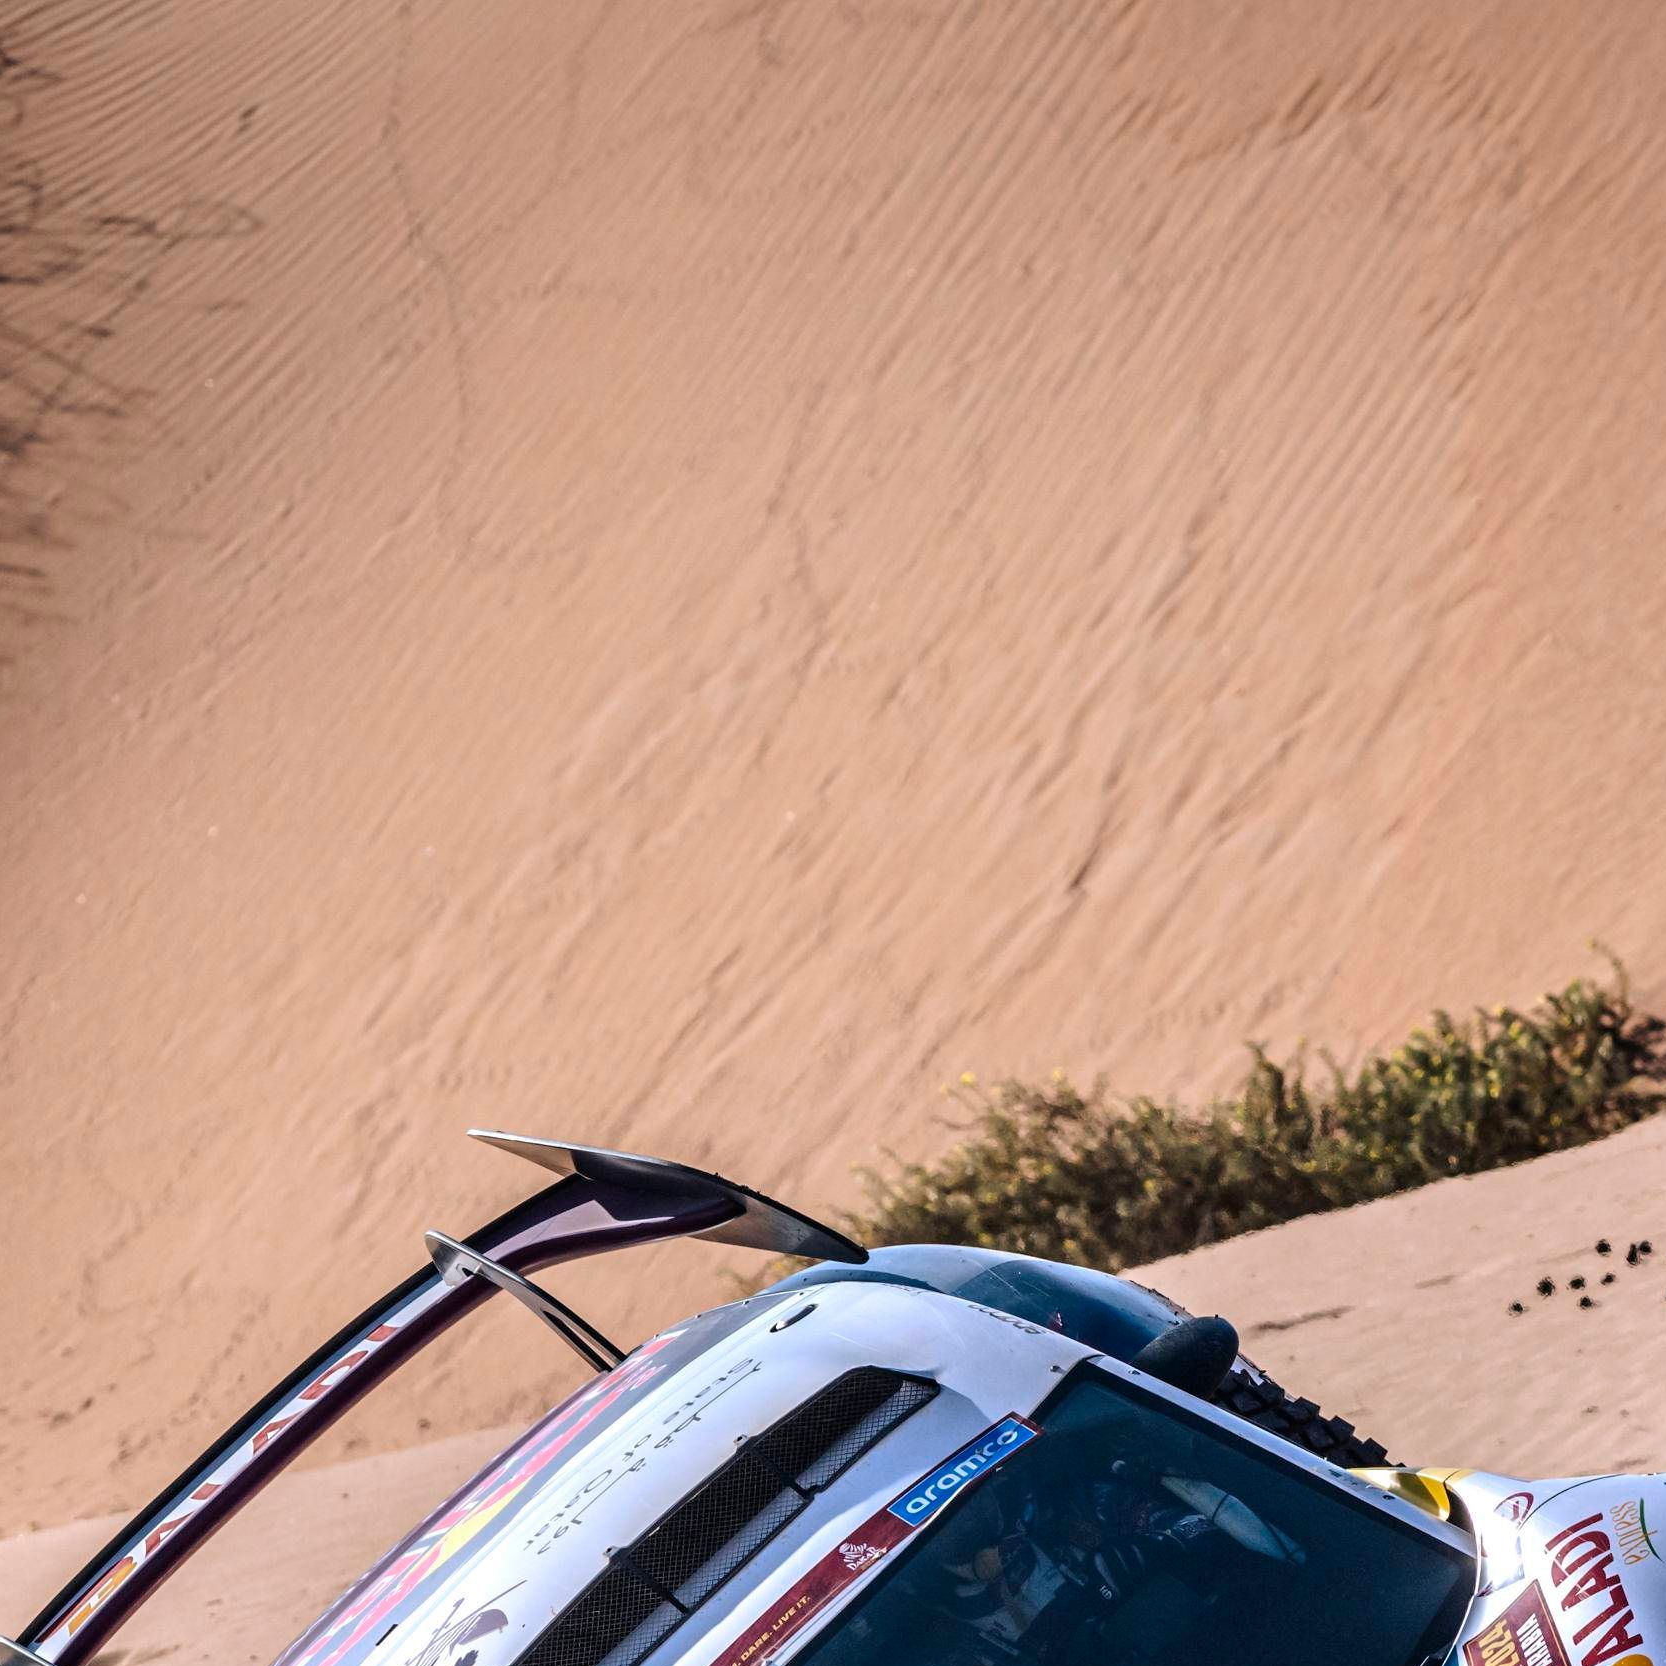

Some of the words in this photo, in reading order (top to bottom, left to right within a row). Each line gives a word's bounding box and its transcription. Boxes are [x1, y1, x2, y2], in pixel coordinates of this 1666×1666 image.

[663, 1358, 754, 1425] State
[622, 1433, 652, 1462] of
[906, 1430, 1018, 1514] aramco
[523, 1469, 613, 1551] Qatar
[1609, 1499, 1659, 1565] express
[740, 1631, 773, 1661] DARE.
[773, 1605, 797, 1631] LIVE
[797, 1595, 810, 1609] IT.
